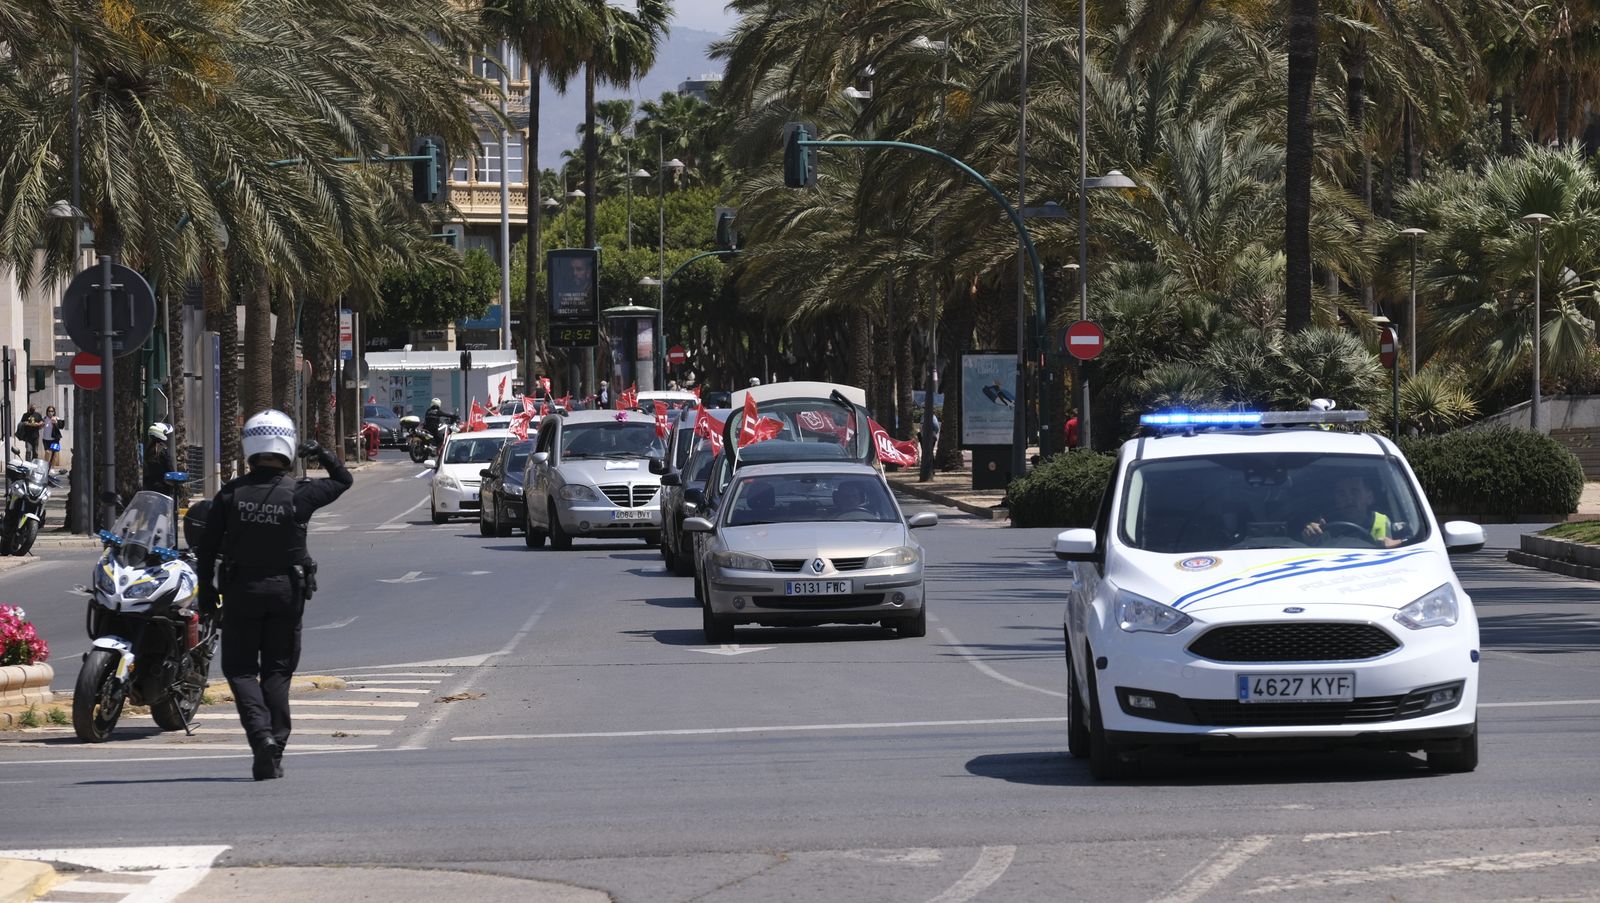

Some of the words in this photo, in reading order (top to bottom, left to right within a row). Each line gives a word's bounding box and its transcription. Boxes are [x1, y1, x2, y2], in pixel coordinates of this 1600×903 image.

[560, 329, 592, 341] 12:52
[240, 512, 281, 525] LOCAL
[794, 582, 820, 594] 6131
[1253, 678, 1304, 696] 4627
[1310, 677, 1349, 696] KYF
